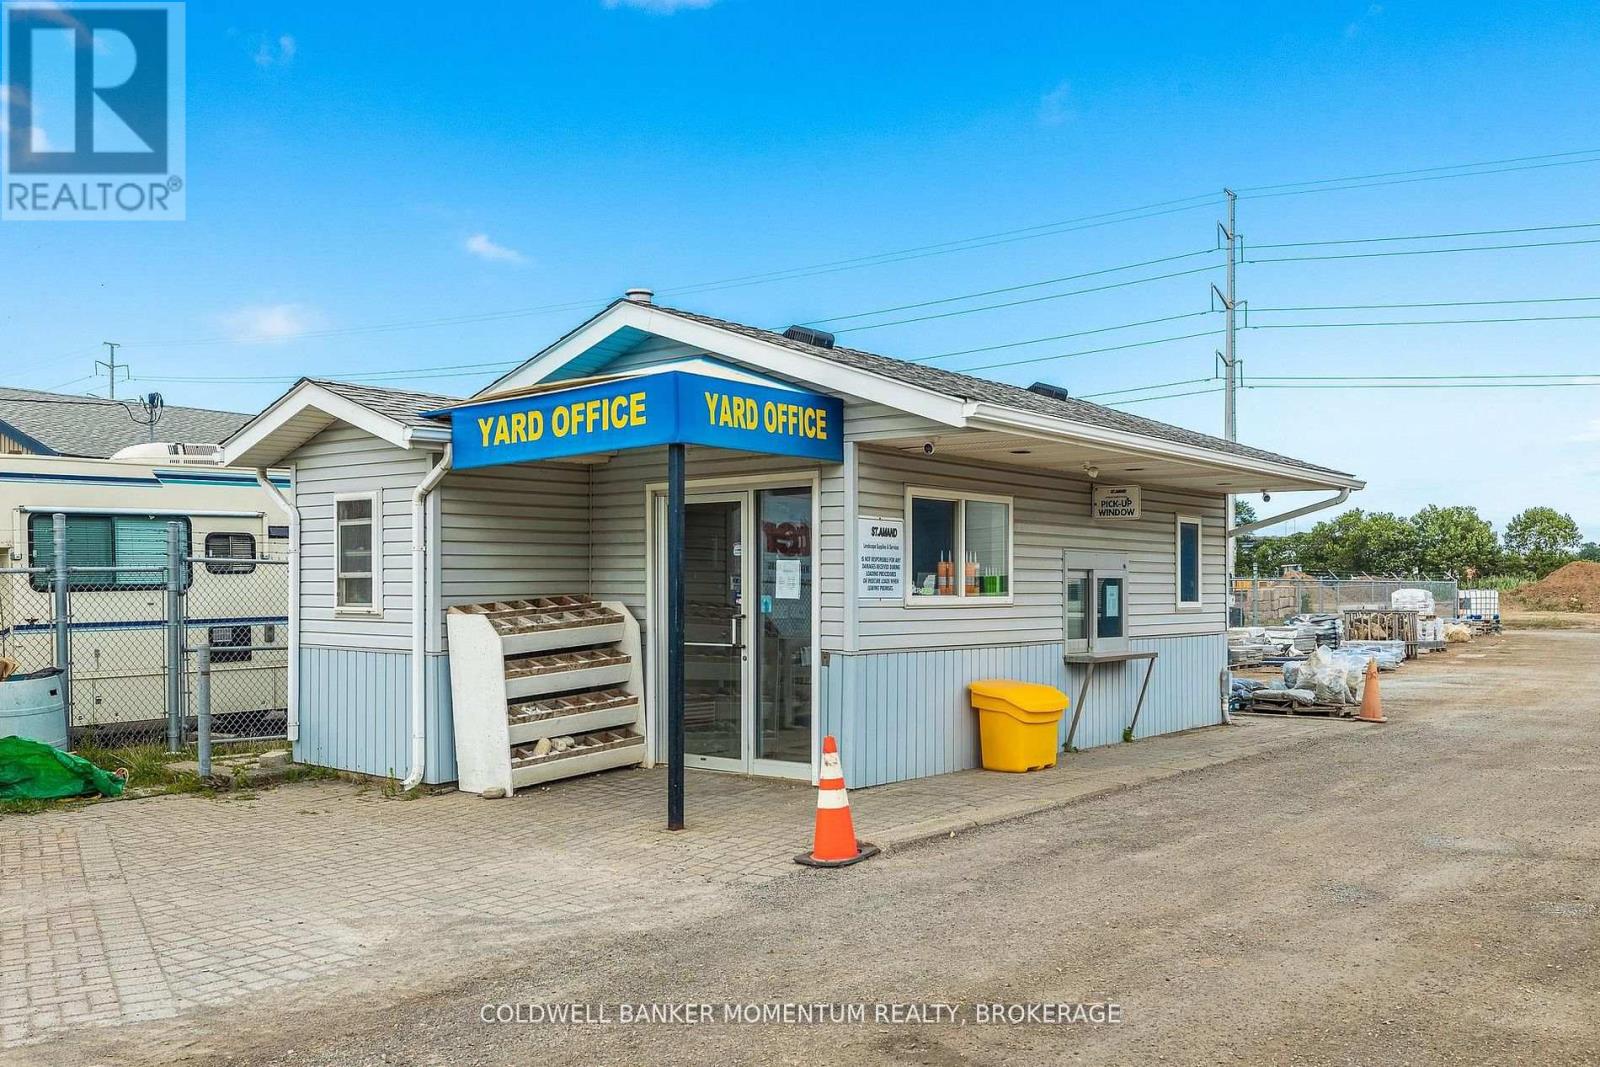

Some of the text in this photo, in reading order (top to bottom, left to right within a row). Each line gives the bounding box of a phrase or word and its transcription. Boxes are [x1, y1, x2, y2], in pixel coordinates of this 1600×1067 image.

[477, 392, 647, 447] YARD OFFICE
[704, 391, 827, 440] YARD OFFICE
[1099, 509, 1135, 517] WINDOW
[1101, 499, 1132, 508] PICK-UP
